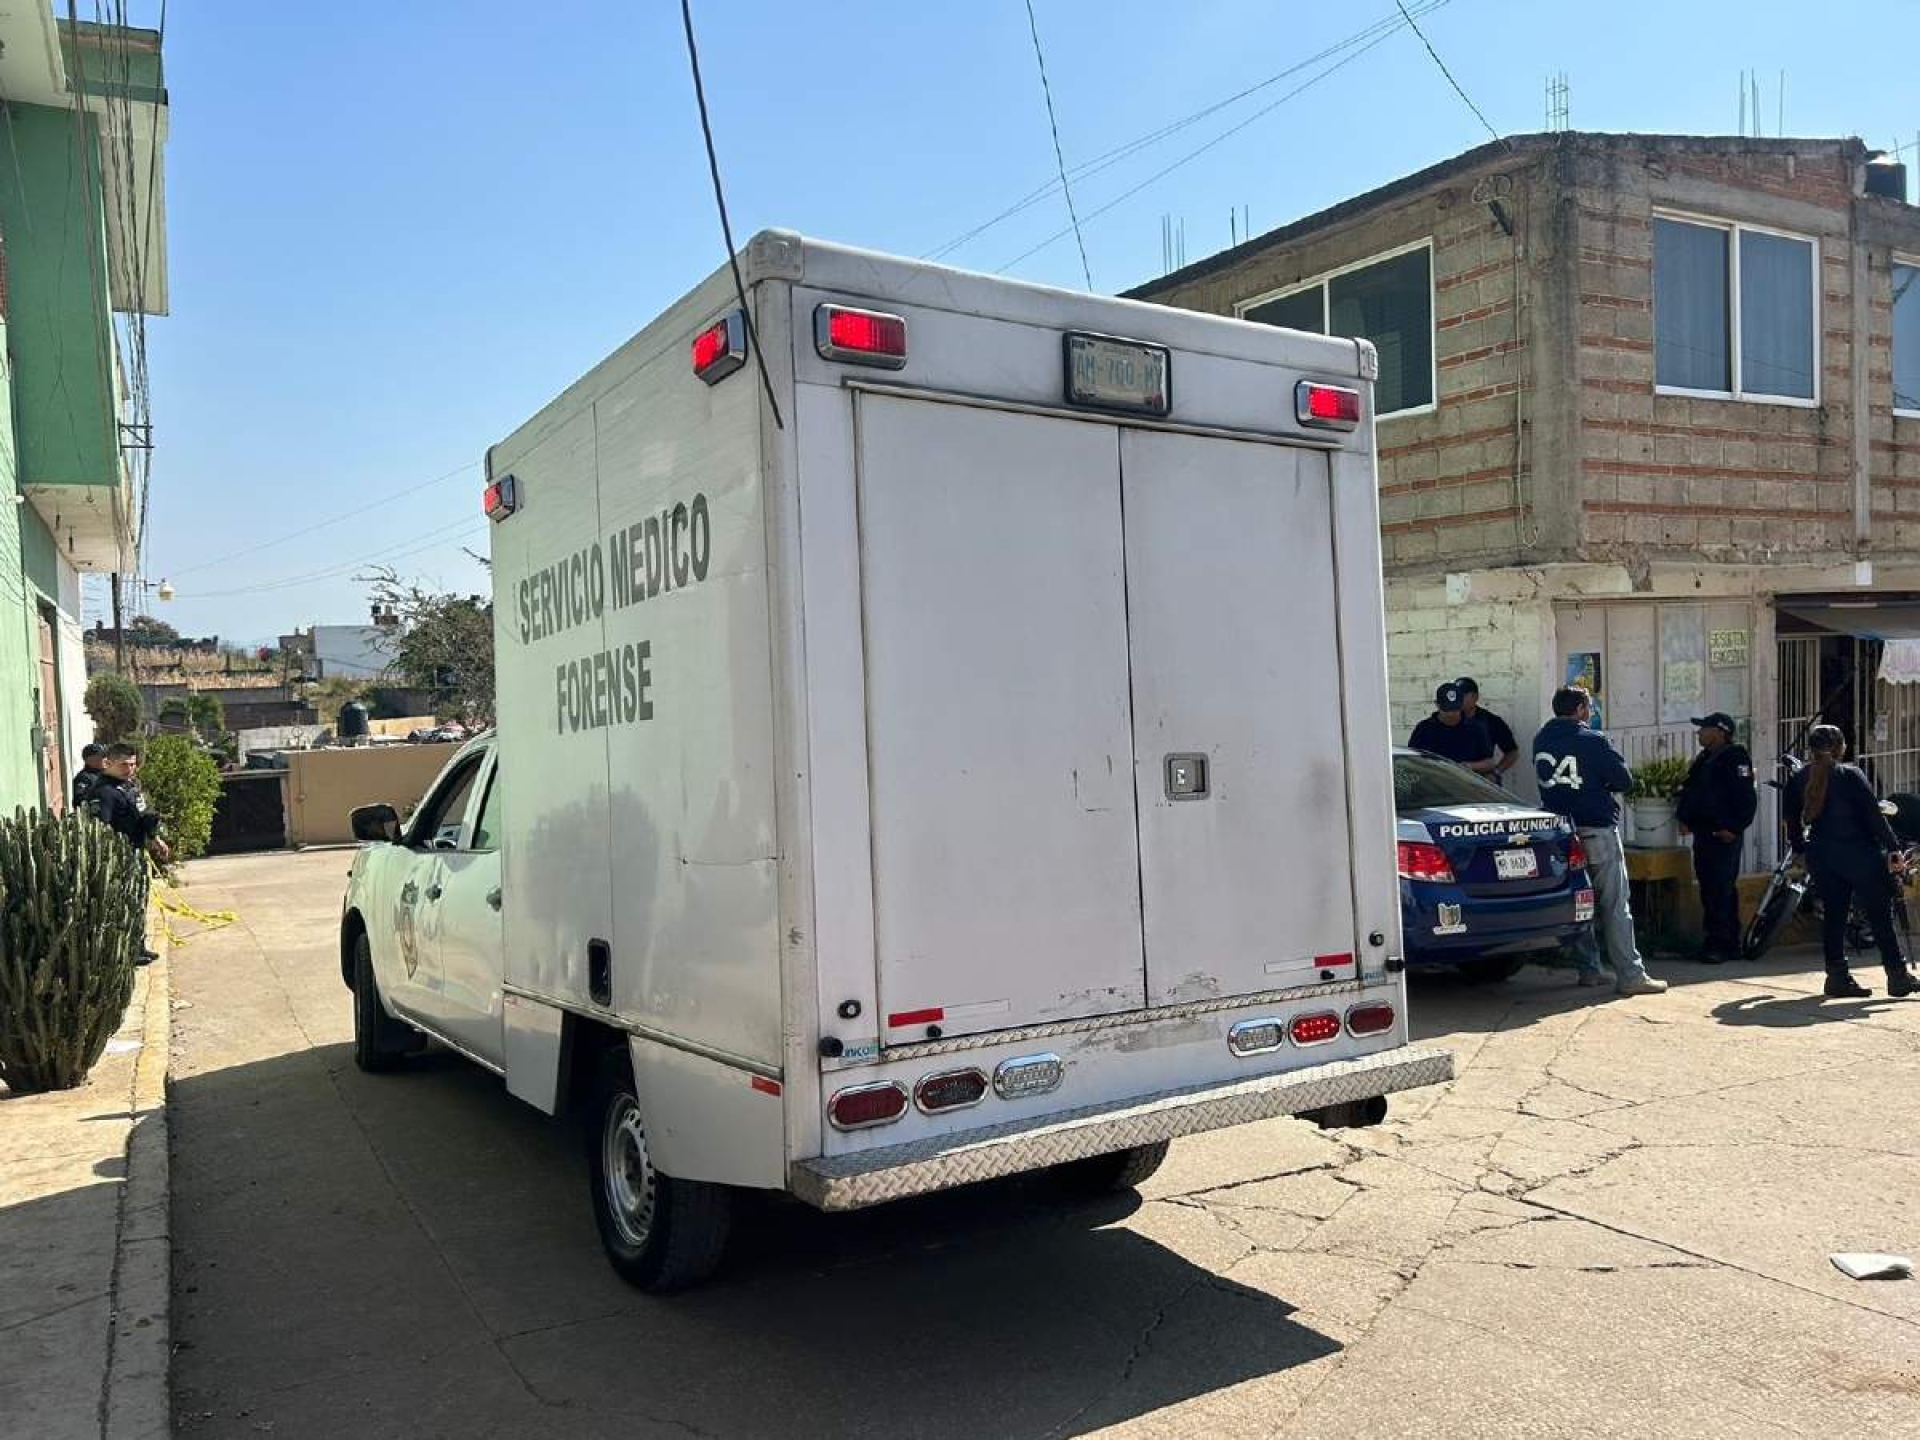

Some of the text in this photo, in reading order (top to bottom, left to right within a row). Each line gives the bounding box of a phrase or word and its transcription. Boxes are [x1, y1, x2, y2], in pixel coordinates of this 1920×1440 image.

[519, 492, 710, 645] SERVICIO MEDICO
[556, 640, 653, 735] FORENSE
[1536, 751, 1583, 790] C4
[1440, 821, 1505, 838] POLICIA
